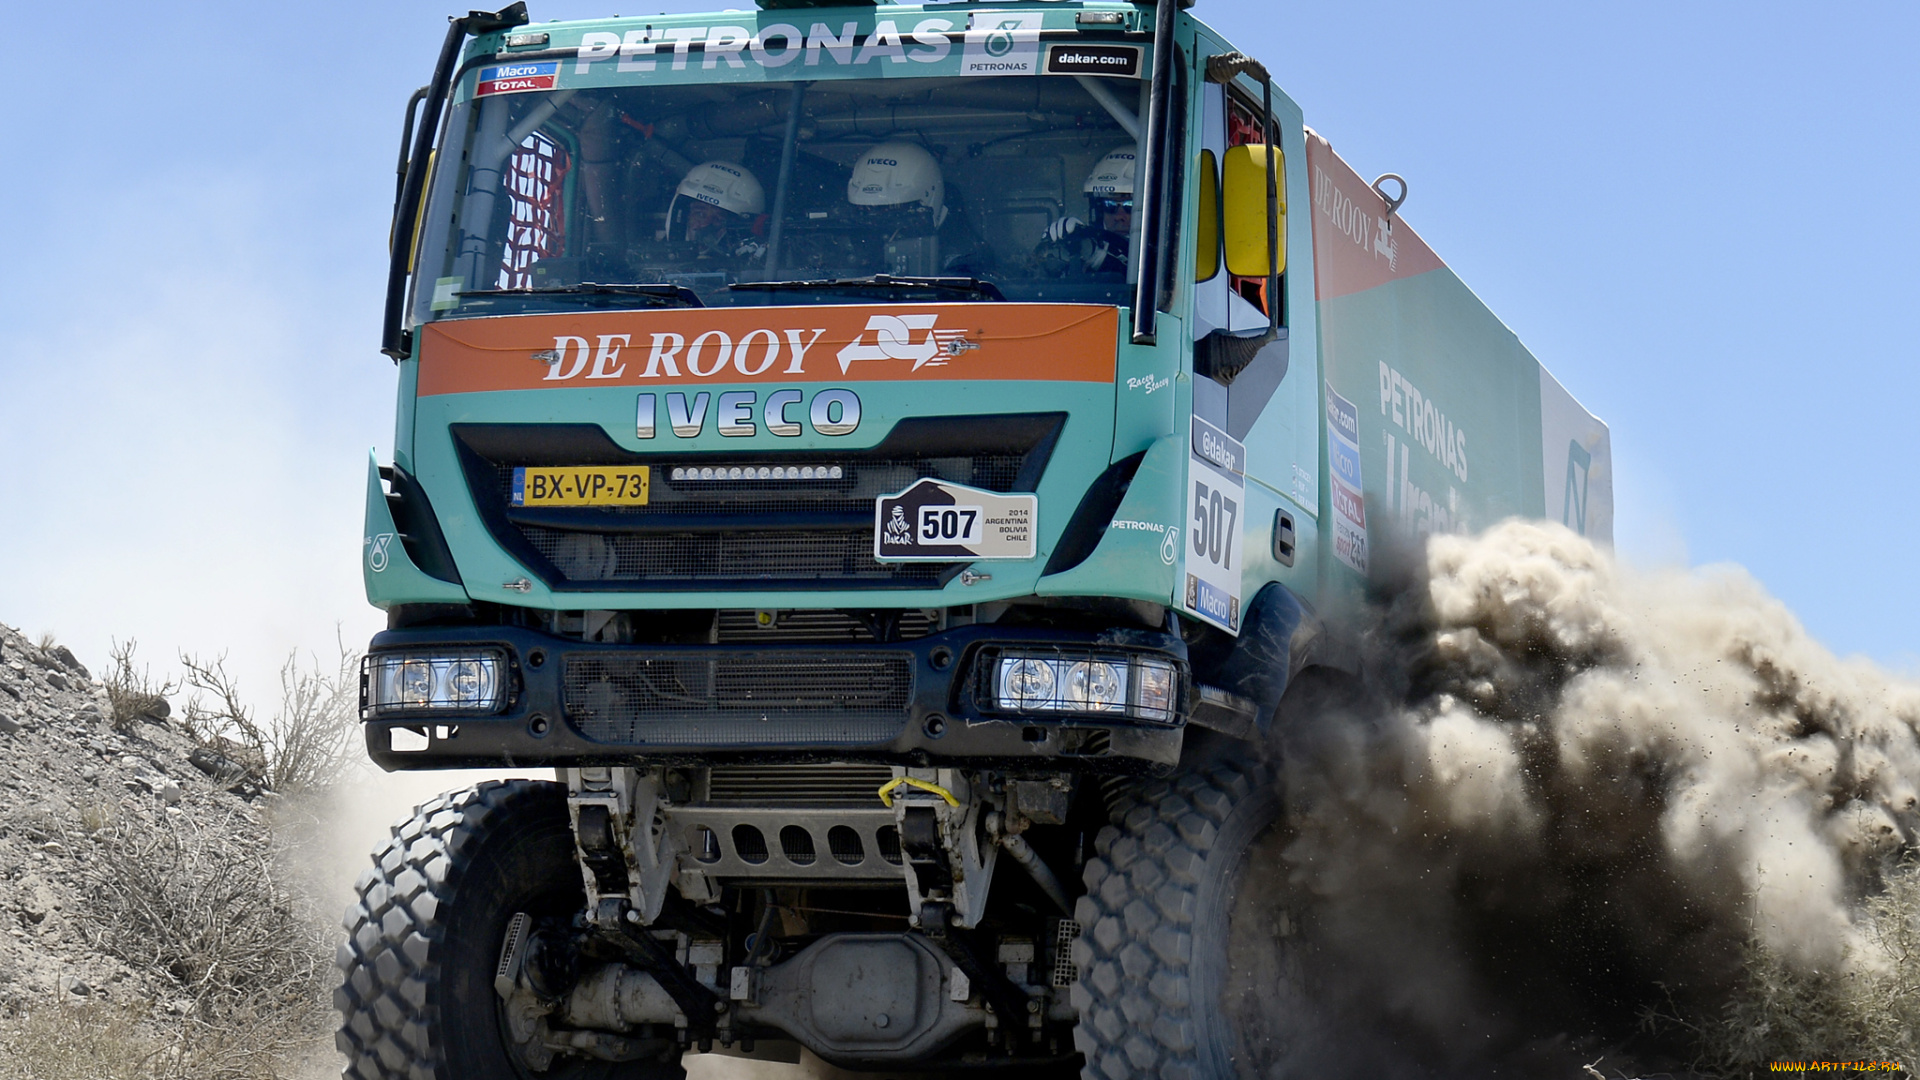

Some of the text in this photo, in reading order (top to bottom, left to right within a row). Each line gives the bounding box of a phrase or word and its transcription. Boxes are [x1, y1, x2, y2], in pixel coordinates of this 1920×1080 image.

[574, 18, 955, 75] PETRONAS
[969, 62, 1028, 71] PETRONAS
[1058, 53, 1128, 66] dakar.com
[497, 64, 538, 78] Macro
[493, 79, 536, 91] TOTAL
[867, 158, 898, 167] IVECO
[710, 164, 741, 177] IVECO
[696, 193, 720, 205] IVECO
[1314, 164, 1371, 252] DE ROOY
[542, 328, 827, 381] DE ROOY
[1126, 373, 1154, 391] Racey
[1145, 377, 1169, 395] Stacey
[635, 388, 862, 440] IVECO
[1379, 360, 1468, 483] PETRONAS
[1202, 431, 1236, 470] @dakar
[531, 474, 642, 499] BX-VP-73
[513, 492, 523, 501] NL
[1008, 509, 1028, 517] 2014
[922, 510, 977, 540] 507
[985, 517, 1028, 526] ARGENTINA
[1112, 520, 1164, 533] PETRONAS
[1193, 480, 1238, 571] 507
[999, 526, 1028, 534] BOLIVIA
[884, 531, 912, 546] DAKAR
[1006, 534, 1028, 542] CHILE
[1200, 586, 1227, 620] Macro
